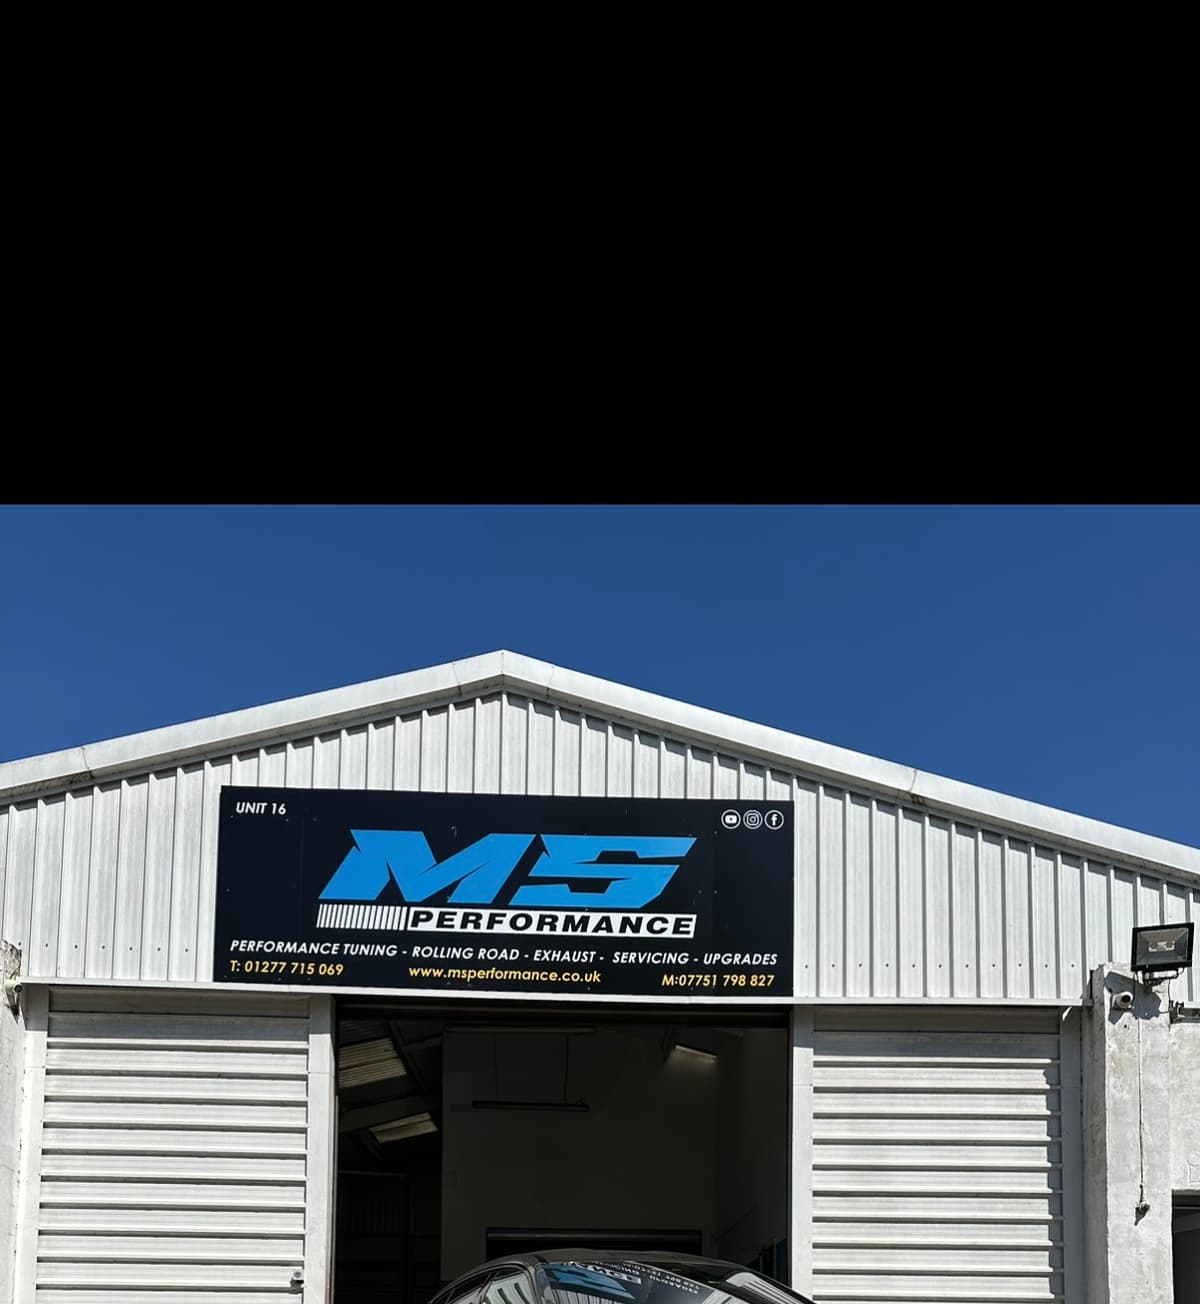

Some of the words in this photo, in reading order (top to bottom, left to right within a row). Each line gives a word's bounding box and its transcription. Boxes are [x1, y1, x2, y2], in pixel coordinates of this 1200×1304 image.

[235, 801, 267, 815] UNIT
[271, 802, 287, 815] 16
[318, 829, 697, 909] MS
[410, 910, 694, 936] PERFORMANCE
[229, 939, 340, 955] PERFORMANCE
[343, 943, 398, 958] TUNING
[412, 945, 474, 961] ROLLING
[477, 947, 520, 961] ROAD
[533, 949, 597, 963] EXHAUST
[612, 951, 689, 966] SERVICING
[703, 952, 778, 967] UPGRADES
[229, 959, 241, 972] T:
[244, 960, 287, 974] 01277
[290, 962, 316, 975] 715
[318, 963, 344, 976] 069
[408, 967, 602, 984] www.msperformance.co.uk
[661, 974, 717, 988] M:07751
[722, 974, 747, 987] 798
[749, 974, 775, 987] 827
